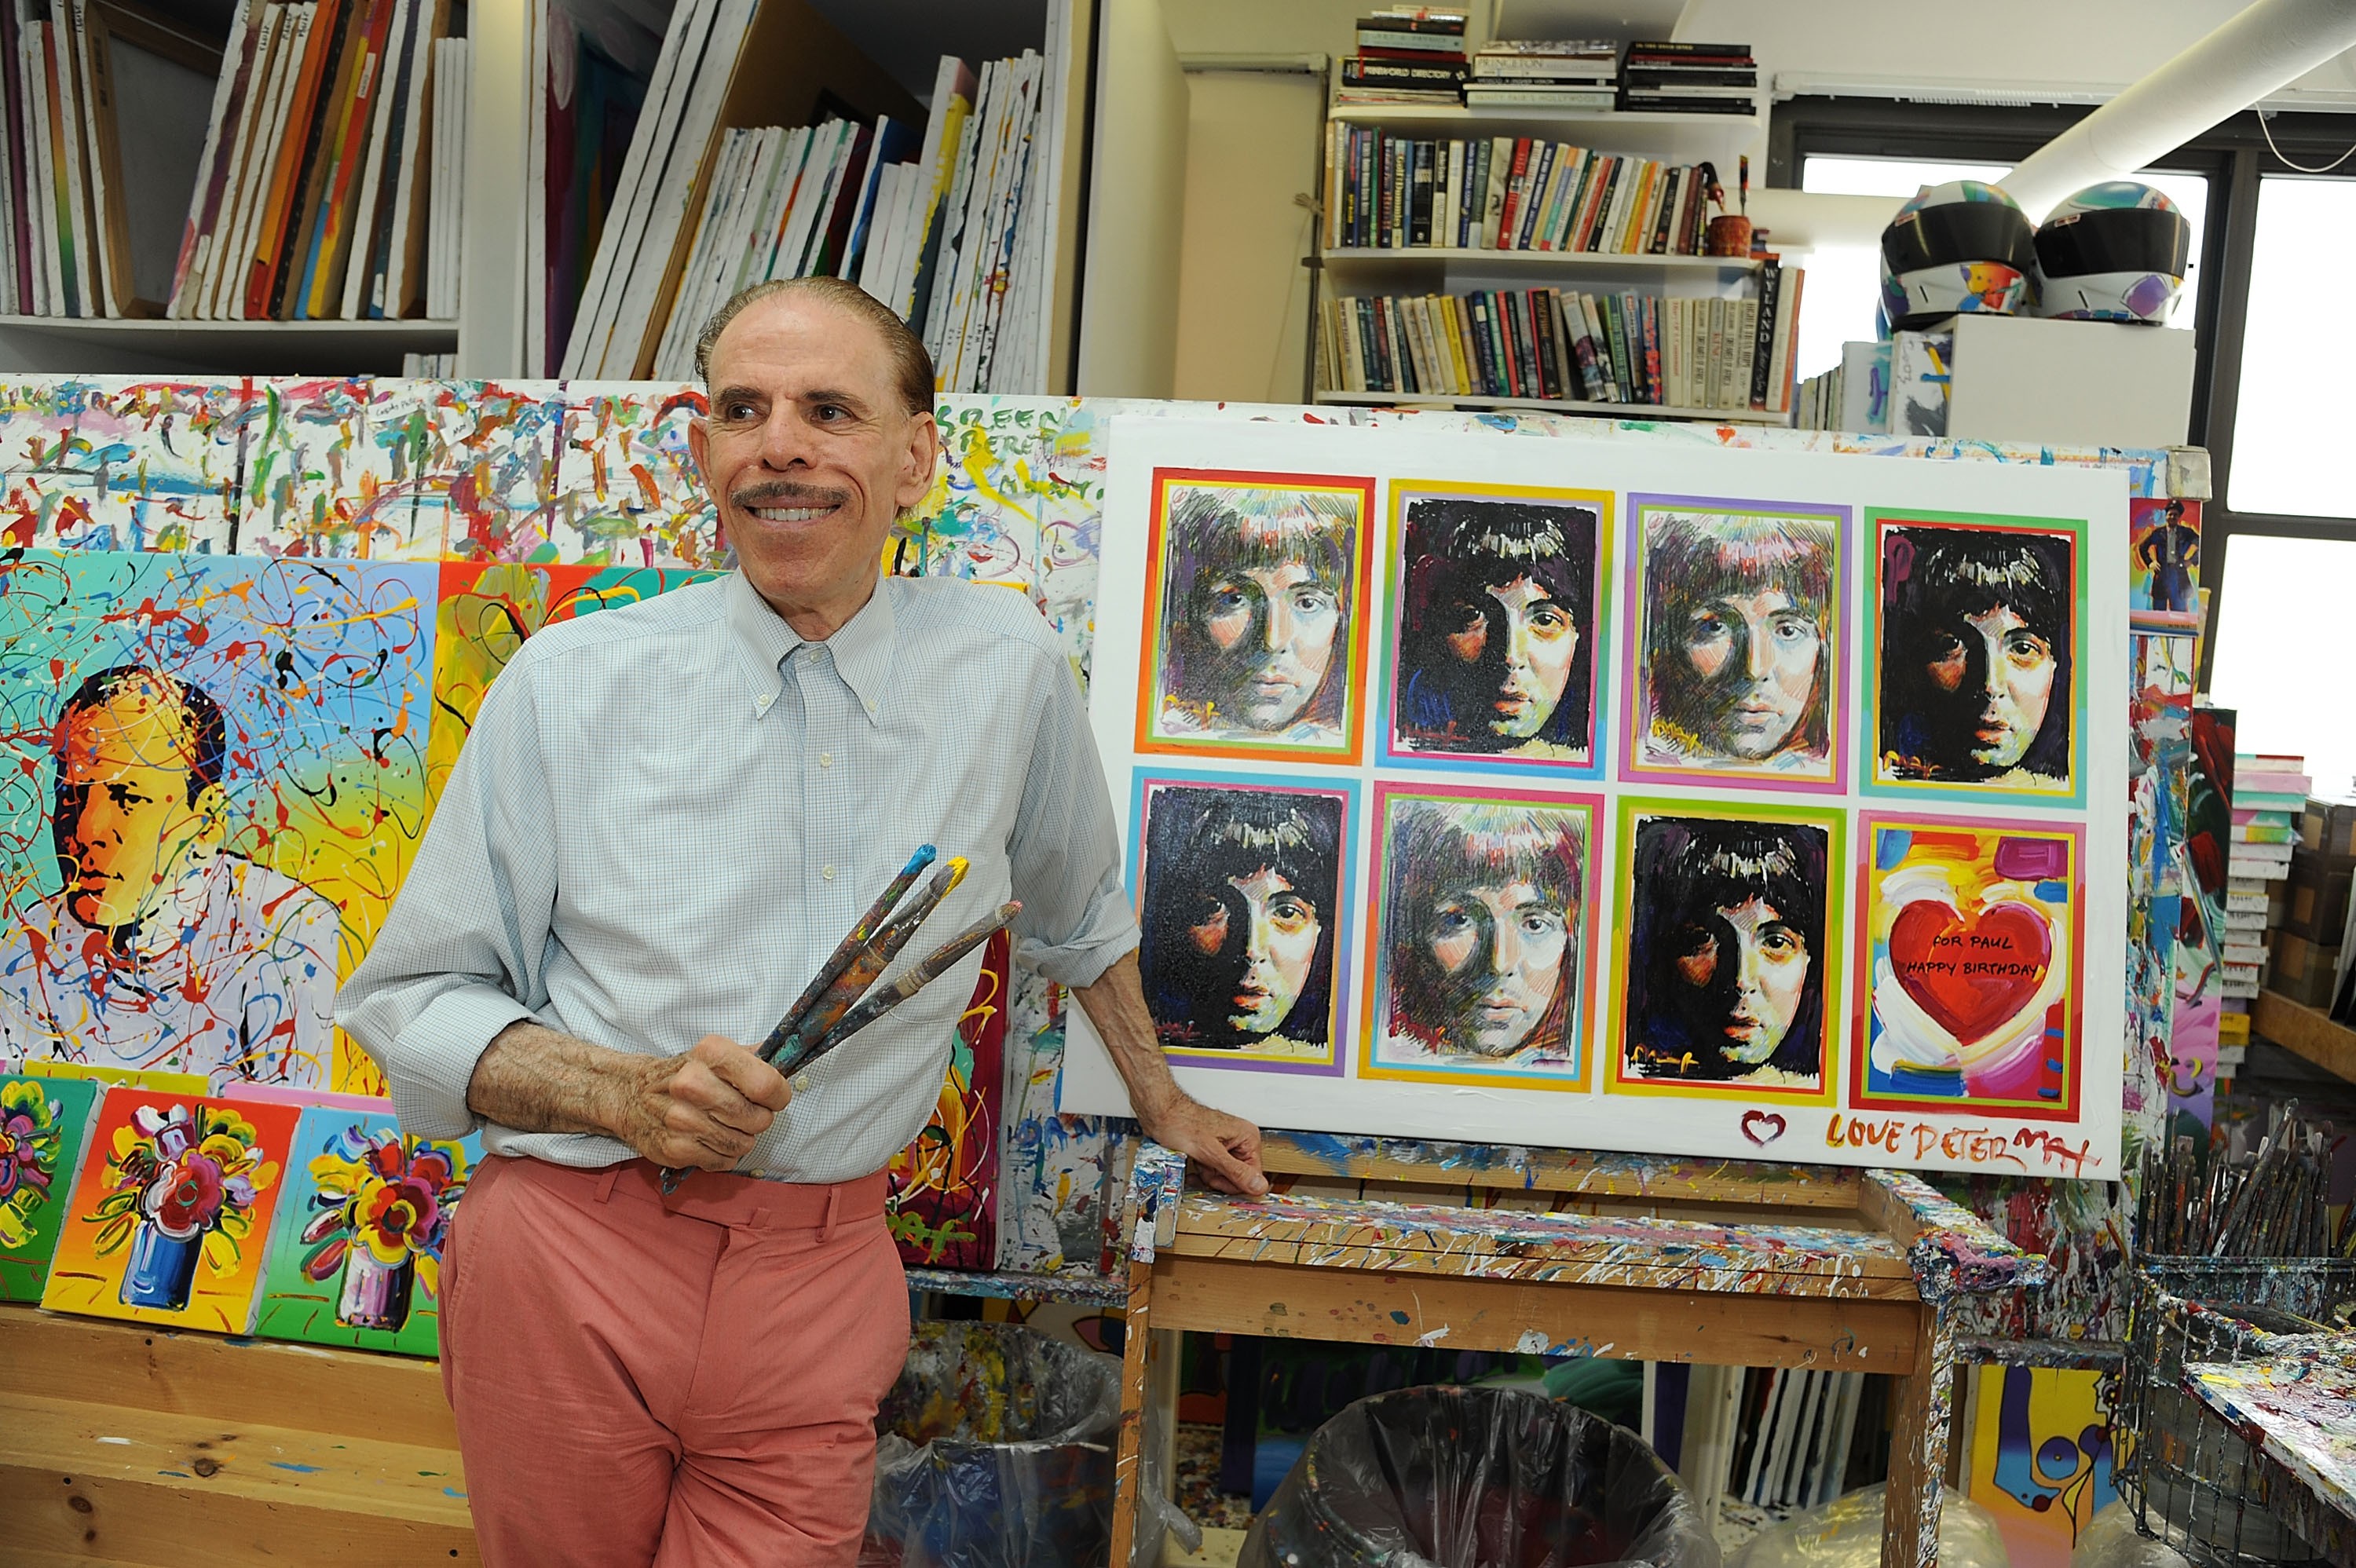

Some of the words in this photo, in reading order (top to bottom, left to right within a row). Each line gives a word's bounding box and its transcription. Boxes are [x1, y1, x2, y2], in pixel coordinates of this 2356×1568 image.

[1410, 68, 1451, 79] DIRECTORY
[1538, 93, 1597, 103] HOLLYWOOD
[1758, 266, 1779, 343] WYLAND
[1933, 935, 1964, 949] FOR
[1970, 936, 2014, 950] PAUL
[1905, 962, 1957, 976] HAPPY
[1963, 962, 2040, 978] BIRTHDAY
[1826, 1113, 1904, 1154] LOVE
[1910, 1123, 2028, 1172] PETER
